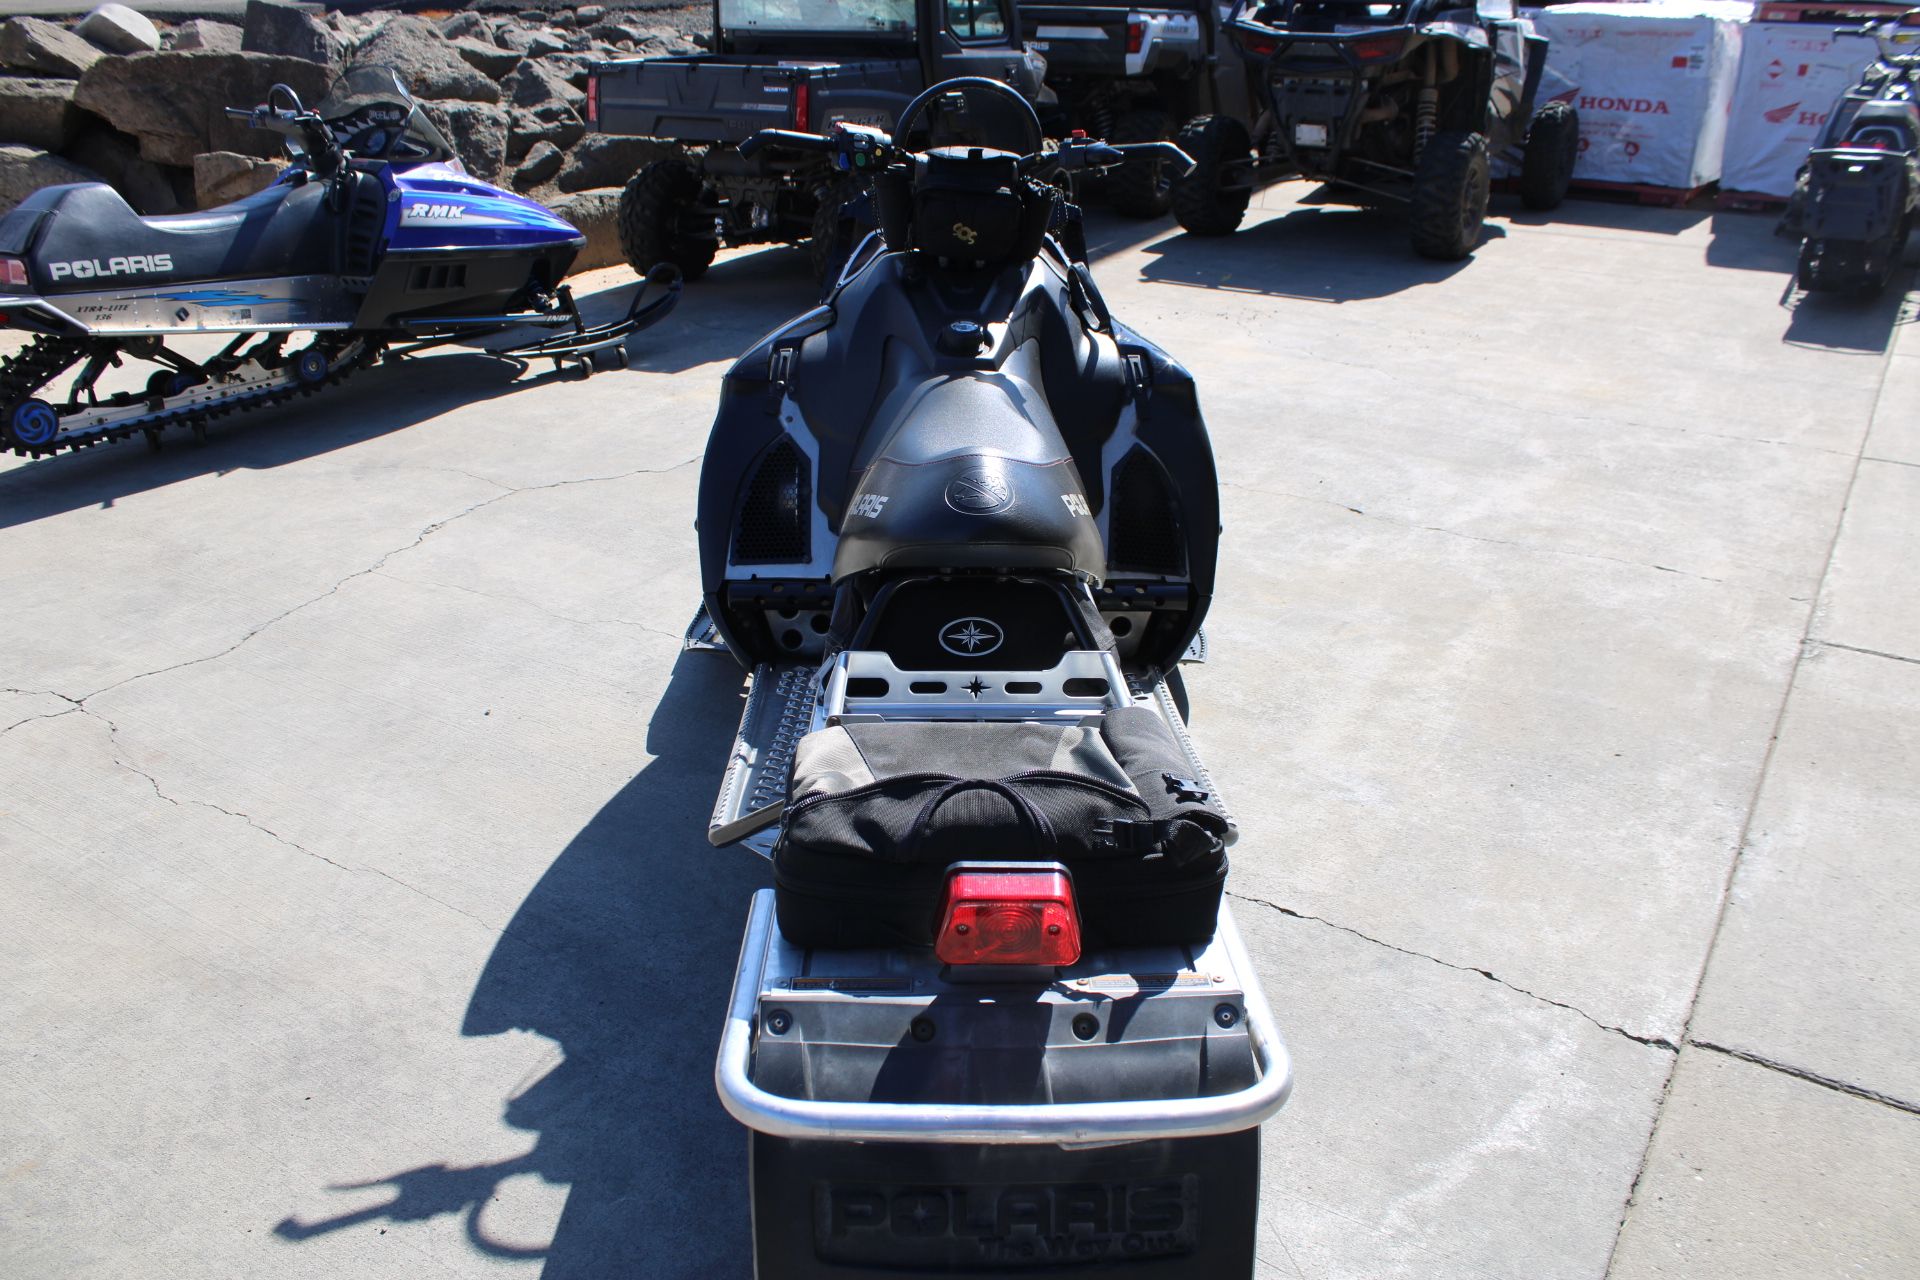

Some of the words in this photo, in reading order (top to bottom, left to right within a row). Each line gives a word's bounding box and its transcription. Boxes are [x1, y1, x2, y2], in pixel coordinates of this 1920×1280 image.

[1580, 96, 1669, 114] HONDA
[408, 203, 465, 219] RMK
[49, 254, 173, 280] POLARIS
[831, 1182, 1184, 1239] POLARIS
[979, 1236, 1034, 1260] The
[1043, 1234, 1112, 1259] Way
